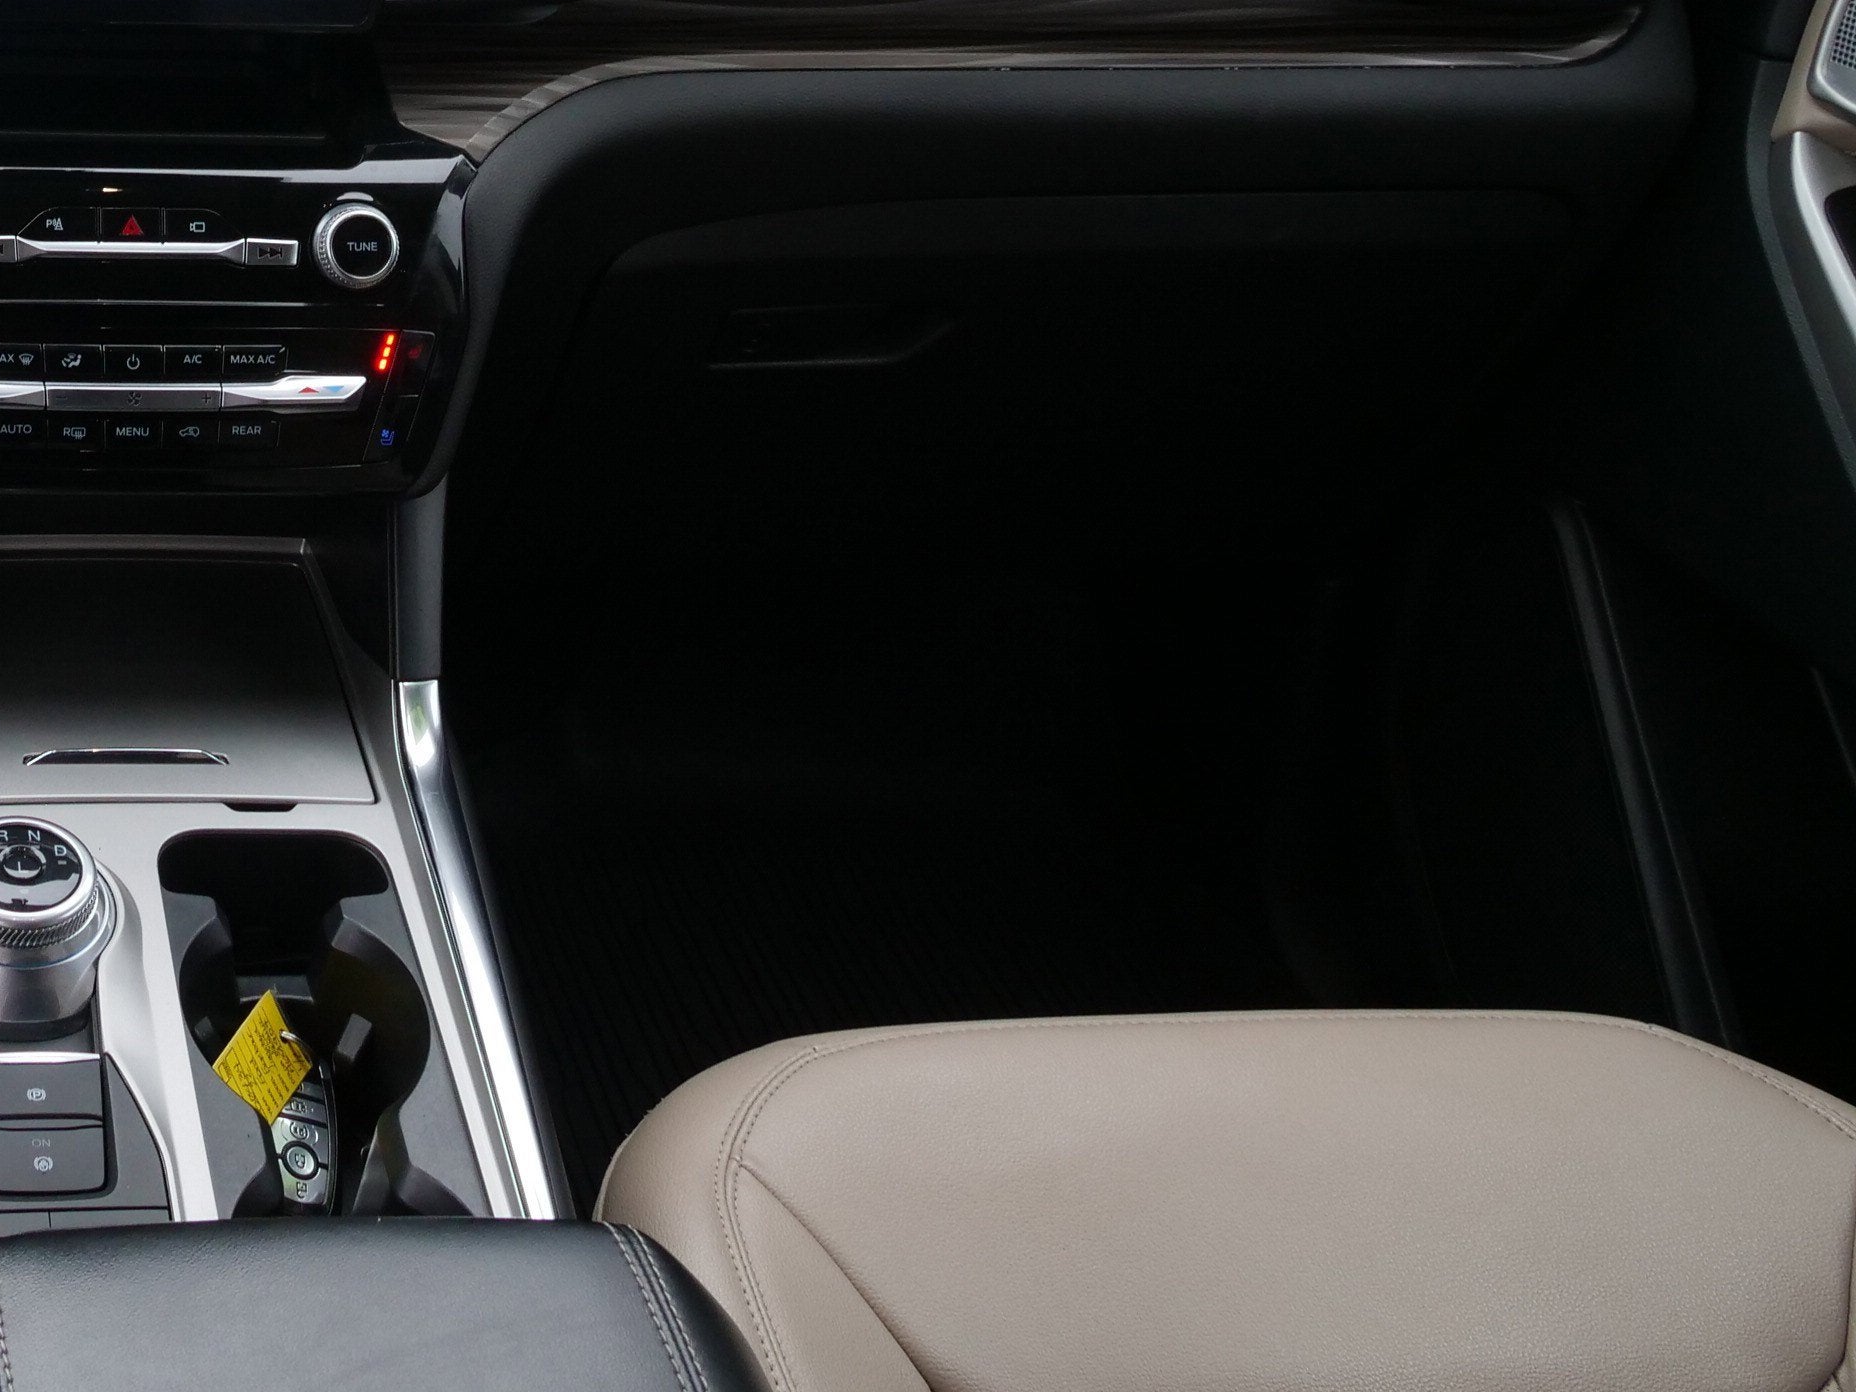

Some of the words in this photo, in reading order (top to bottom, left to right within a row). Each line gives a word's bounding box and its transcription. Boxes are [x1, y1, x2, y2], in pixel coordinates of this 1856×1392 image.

[347, 242, 378, 252] TUNE
[183, 355, 202, 365] A/C
[230, 355, 255, 365] MAX
[256, 355, 276, 365] A/C
[0, 424, 33, 435] AUTO
[116, 427, 150, 437] MENU
[231, 426, 262, 436] REAR
[28, 830, 41, 841] N
[54, 845, 67, 856] D
[31, 1139, 51, 1148] ON
